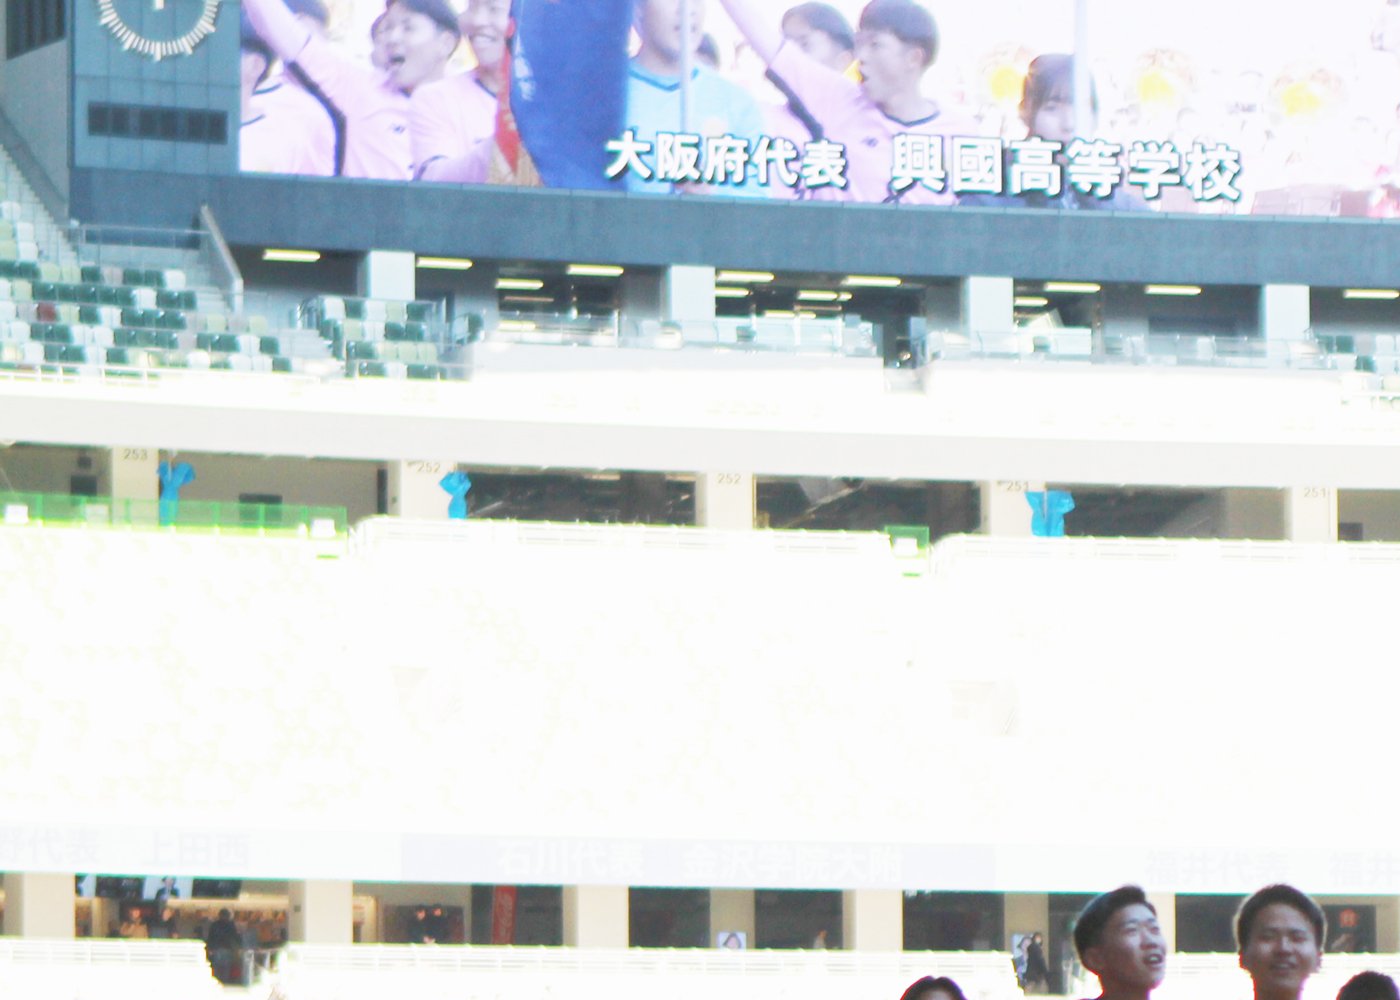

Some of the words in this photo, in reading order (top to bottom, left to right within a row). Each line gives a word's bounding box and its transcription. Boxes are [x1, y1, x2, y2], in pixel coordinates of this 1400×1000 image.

[603, 131, 848, 190] 大阪府代表
[891, 133, 1243, 202] 興國高等学校
[123, 448, 149, 462] 253
[717, 472, 742, 485] 252
[1005, 481, 1029, 493] 251
[1302, 486, 1327, 499] 251
[495, 838, 646, 880] 石川代表
